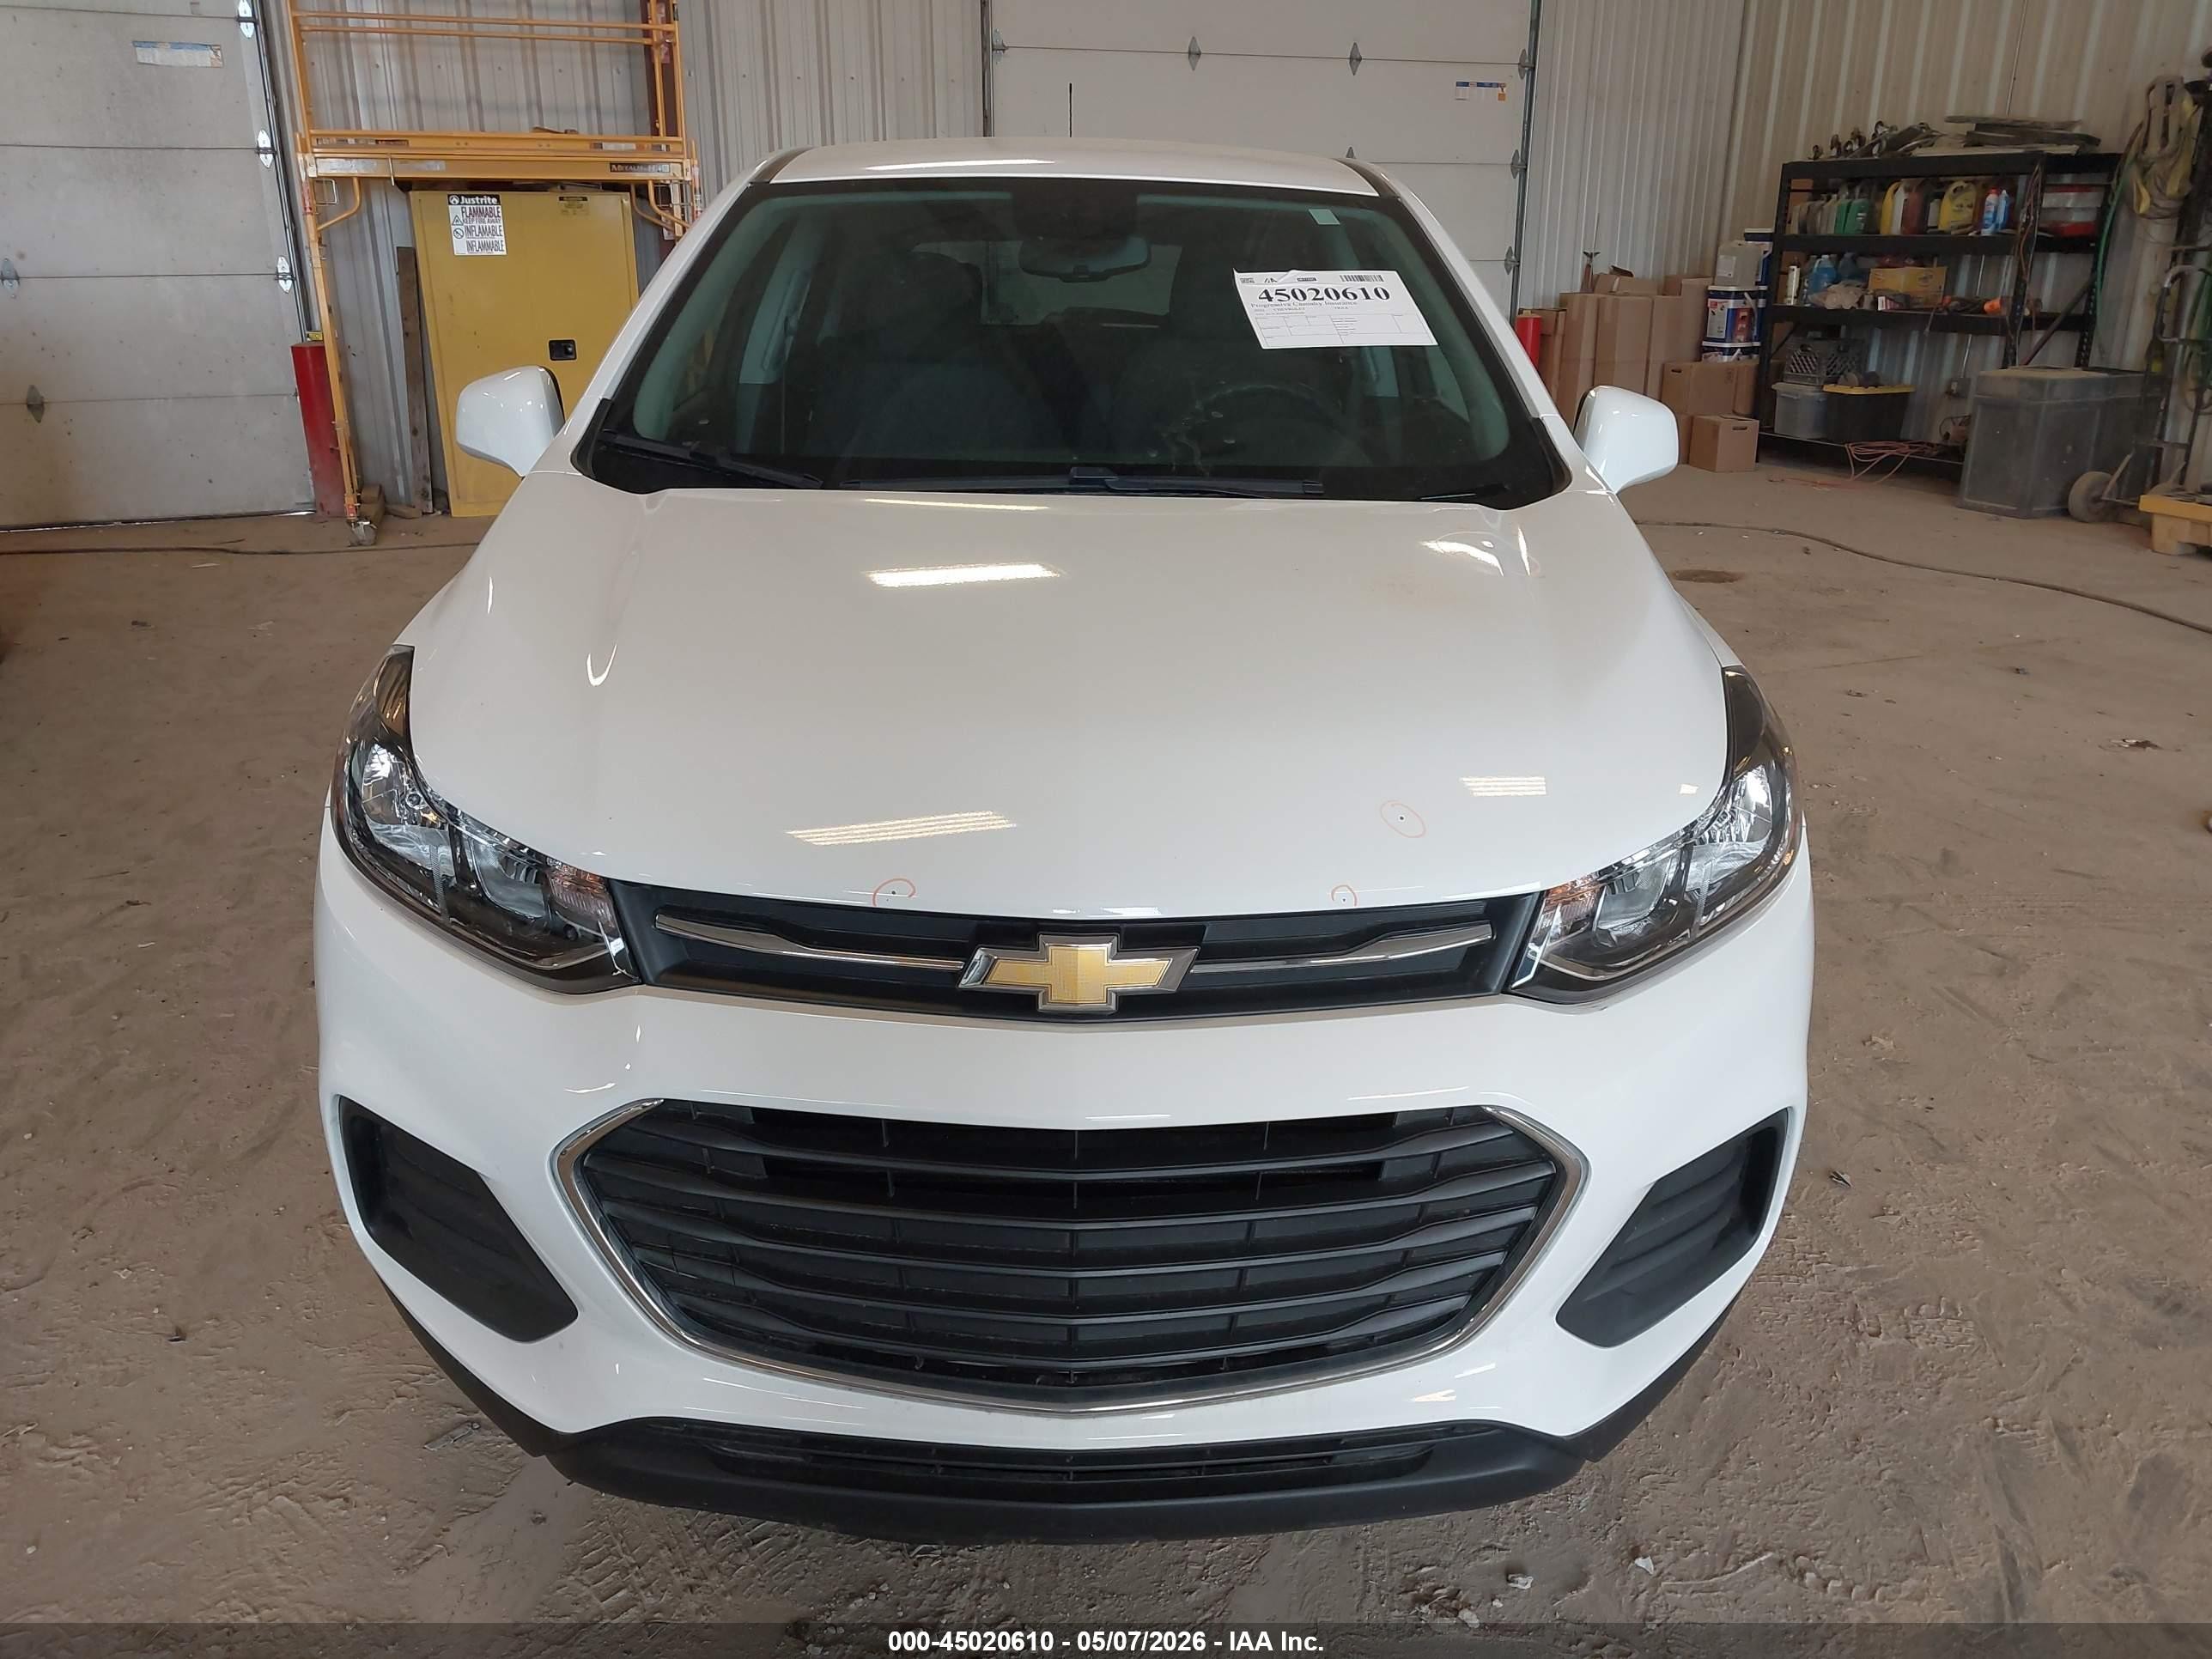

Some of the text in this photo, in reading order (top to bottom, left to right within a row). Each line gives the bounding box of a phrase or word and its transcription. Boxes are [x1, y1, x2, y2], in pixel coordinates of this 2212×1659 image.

[460, 195, 498, 204] Justrite
[461, 207, 501, 218] FLAMMABLE
[465, 225, 503, 237] INFLAMABLE
[466, 240, 505, 252] INFLAMMABLE
[1258, 287, 1390, 302] 45020610
